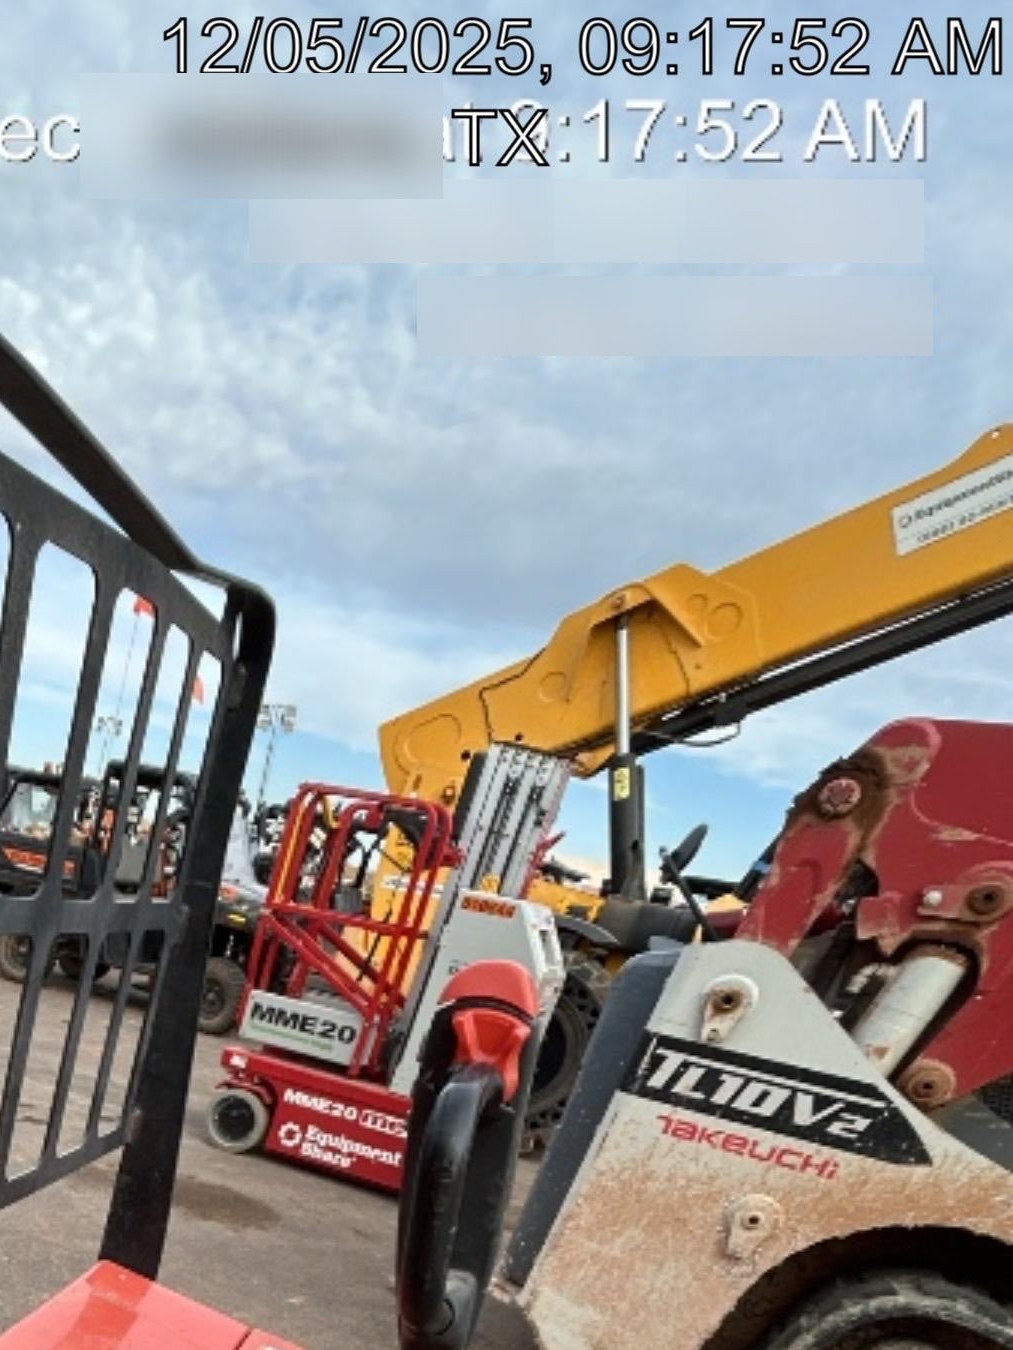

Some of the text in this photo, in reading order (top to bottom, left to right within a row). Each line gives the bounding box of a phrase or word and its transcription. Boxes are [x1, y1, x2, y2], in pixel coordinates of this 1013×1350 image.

[251, 1002, 357, 1045] MME20
[284, 1088, 357, 1120] MME20
[646, 1047, 878, 1139] TL10V2
[304, 1124, 403, 1168] Equipment
